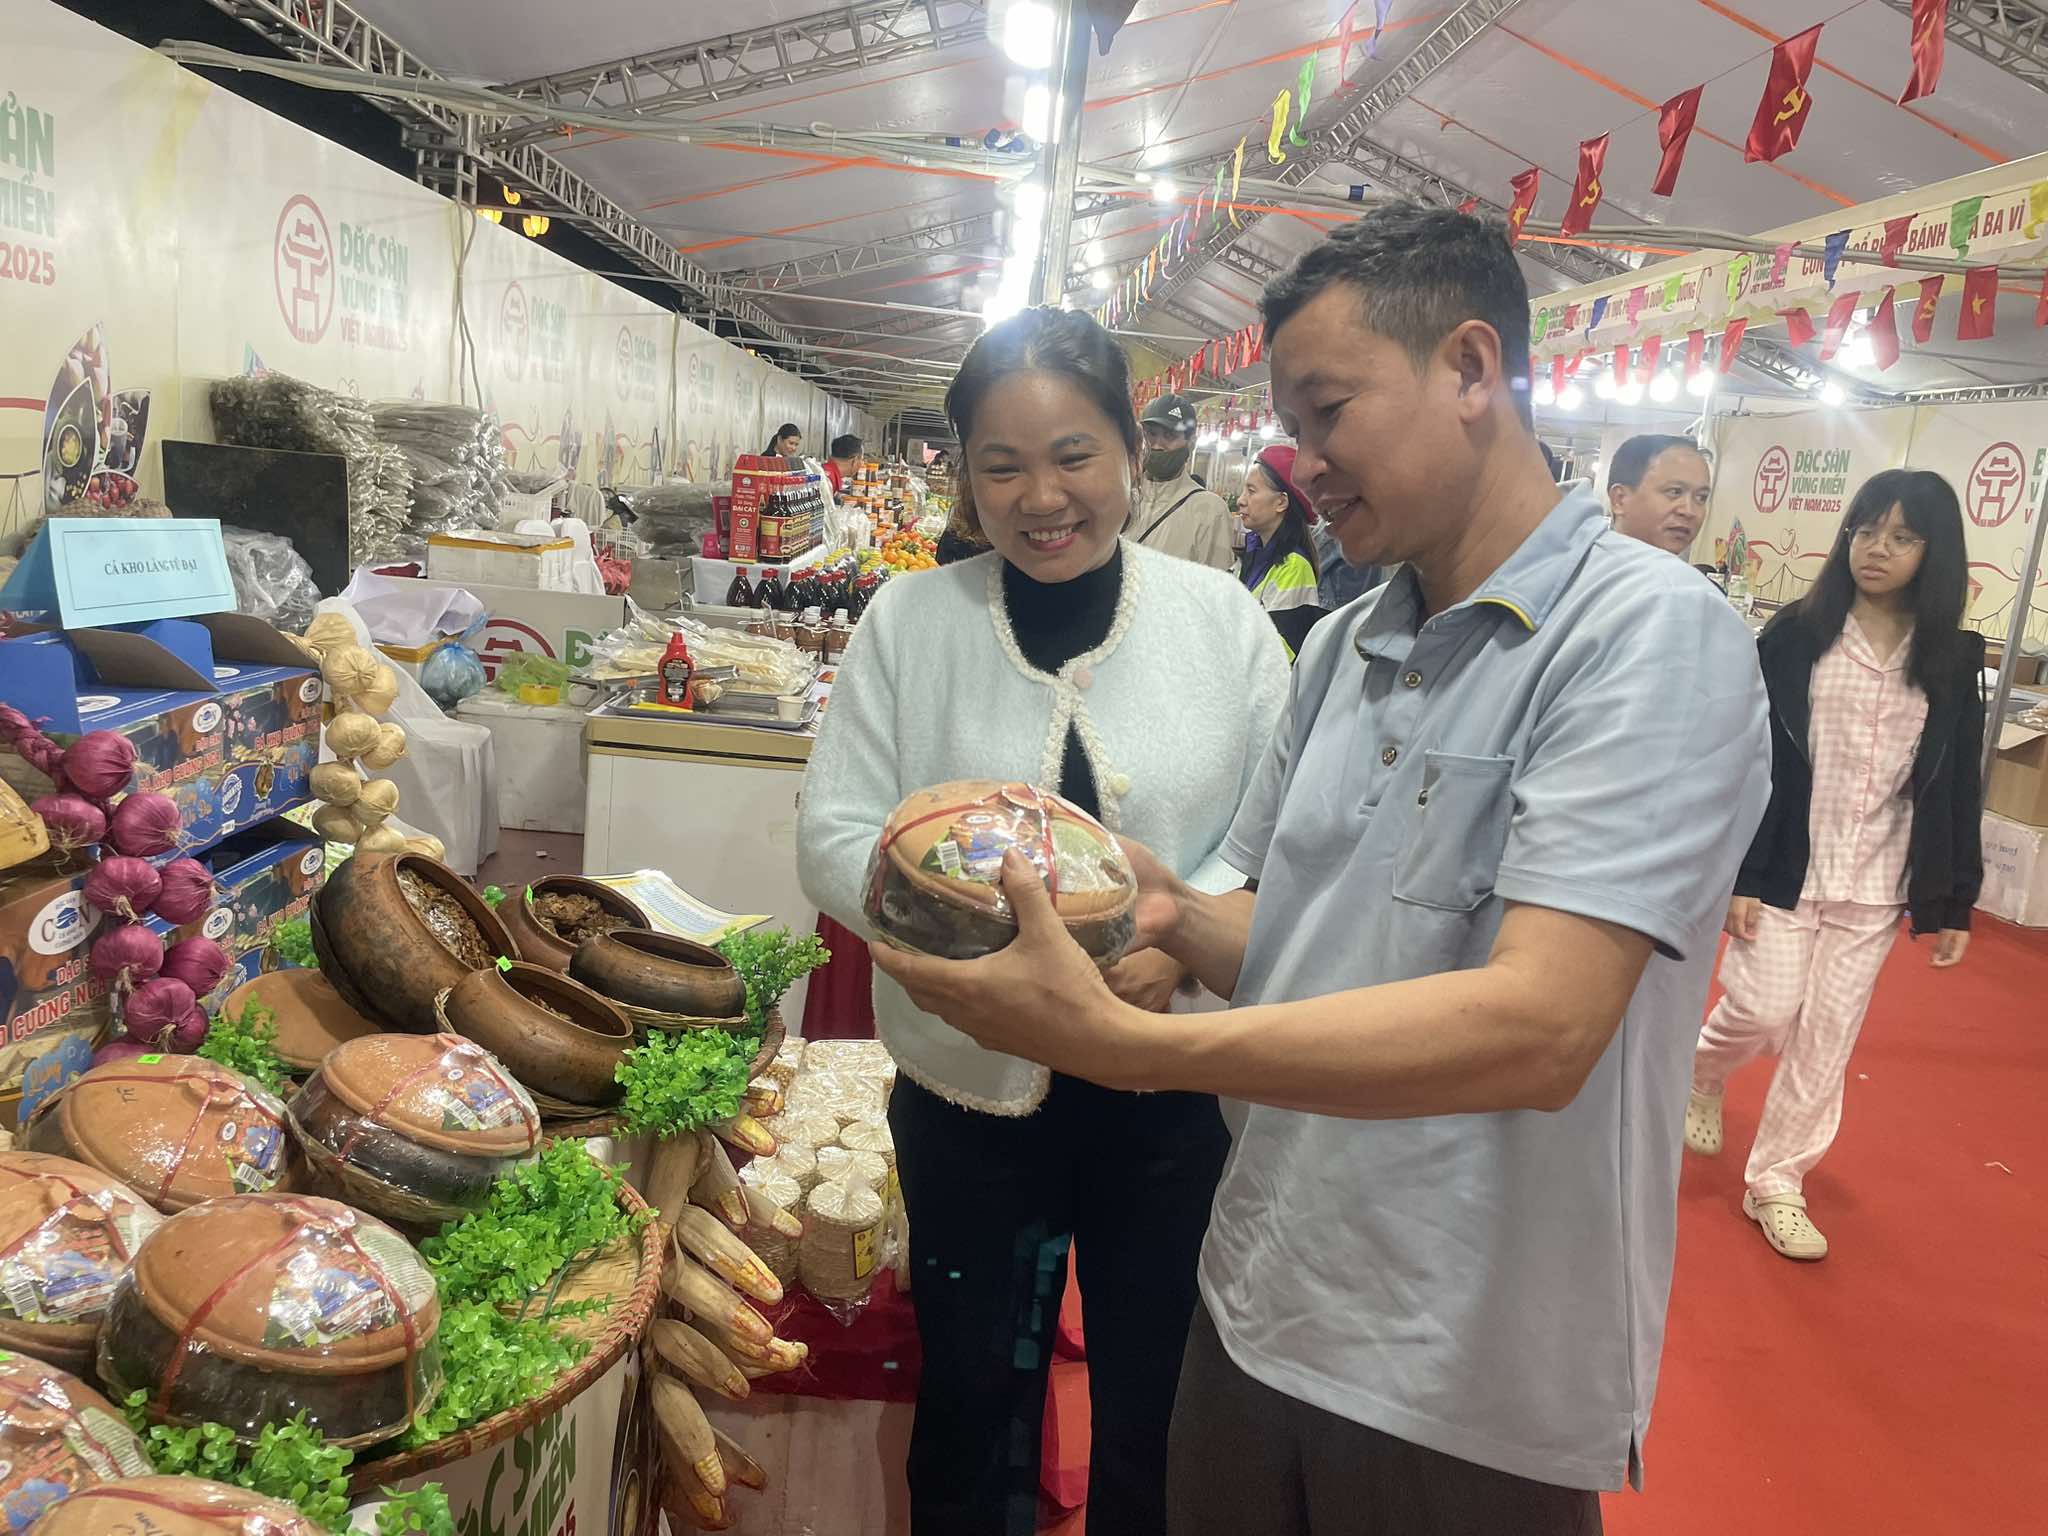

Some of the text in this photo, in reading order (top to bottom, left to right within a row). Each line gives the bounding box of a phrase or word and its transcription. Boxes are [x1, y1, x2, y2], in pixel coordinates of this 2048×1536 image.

[1908, 222, 1948, 252] BÁNH
[1982, 209, 2004, 237] BA
[340, 222, 408, 286] ĐẶC SẢN
[1794, 448, 1851, 474] ĐẶC SẢN
[1791, 474, 1818, 493] VÙNG
[1788, 496, 1803, 513] VIỆT
[1803, 499, 1822, 512] NAM
[1821, 500, 1841, 512] 2025
[104, 559, 120, 575] CÁ
[121, 561, 144, 574] KHO
[56, 959, 81, 986] ĐẶC
